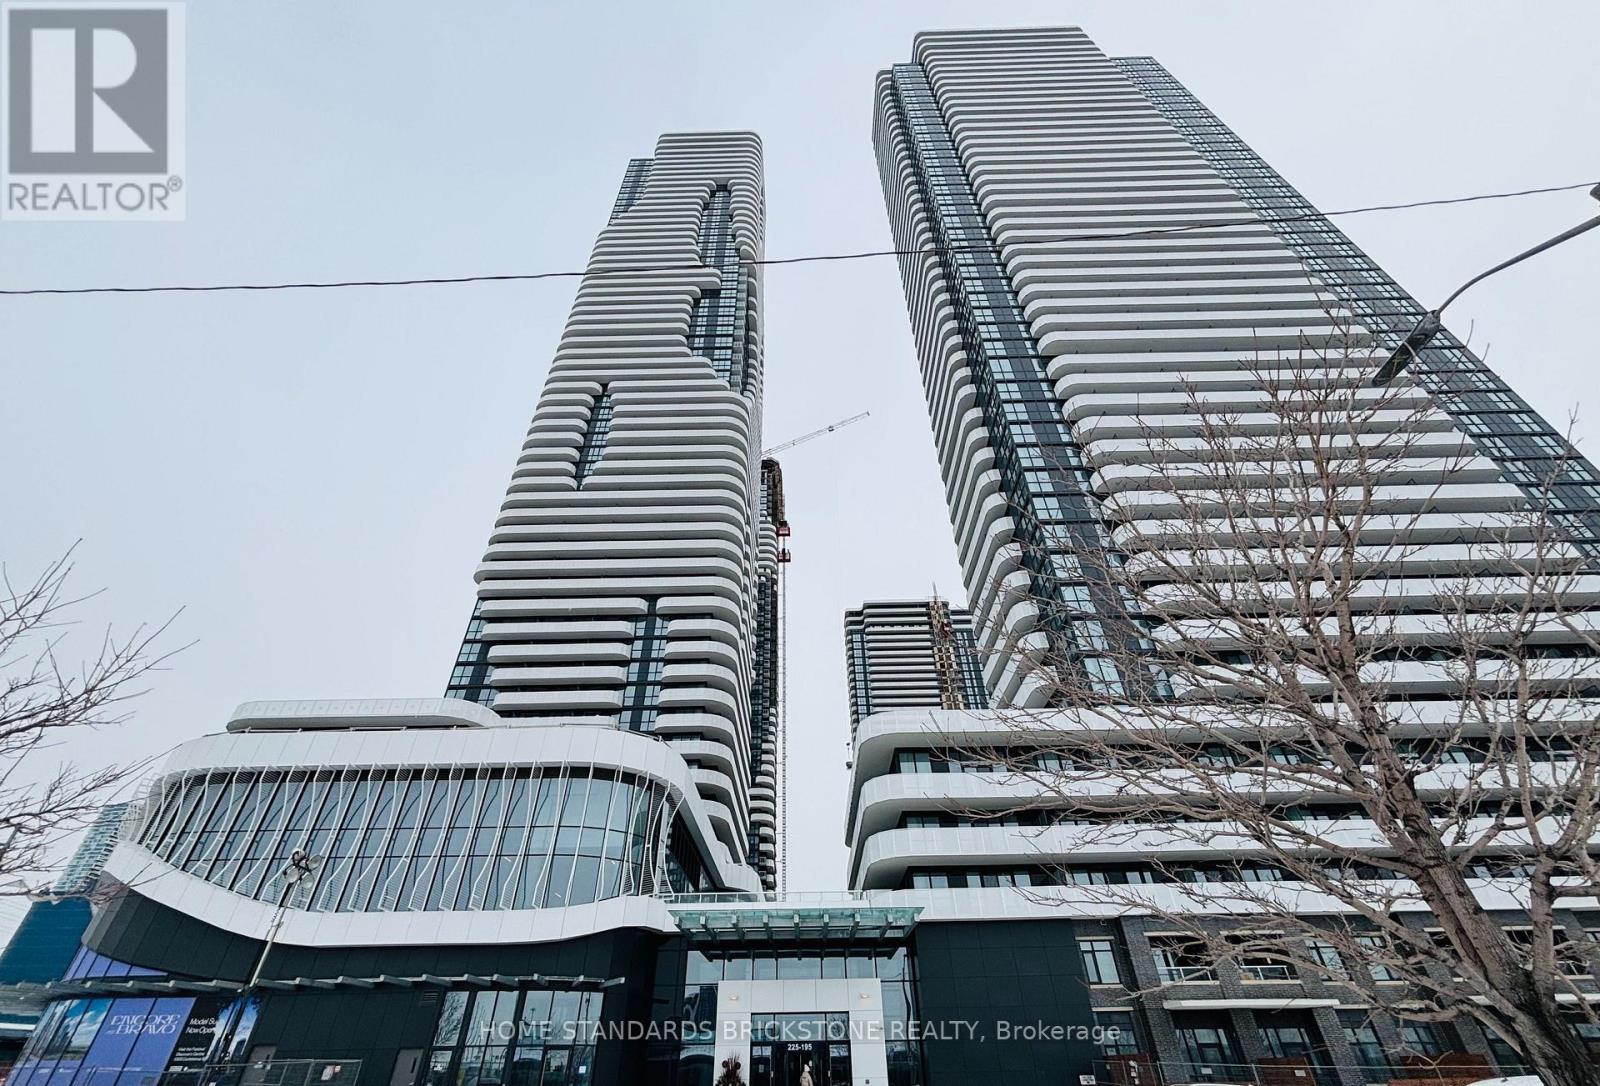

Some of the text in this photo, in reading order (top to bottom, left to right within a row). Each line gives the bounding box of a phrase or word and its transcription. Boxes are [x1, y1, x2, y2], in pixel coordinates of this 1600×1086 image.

[111, 1014, 180, 1025] ENCORE
[189, 1017, 209, 1025] Model
[115, 1024, 177, 1035] BRAVO
[185, 1026, 199, 1034] Now
